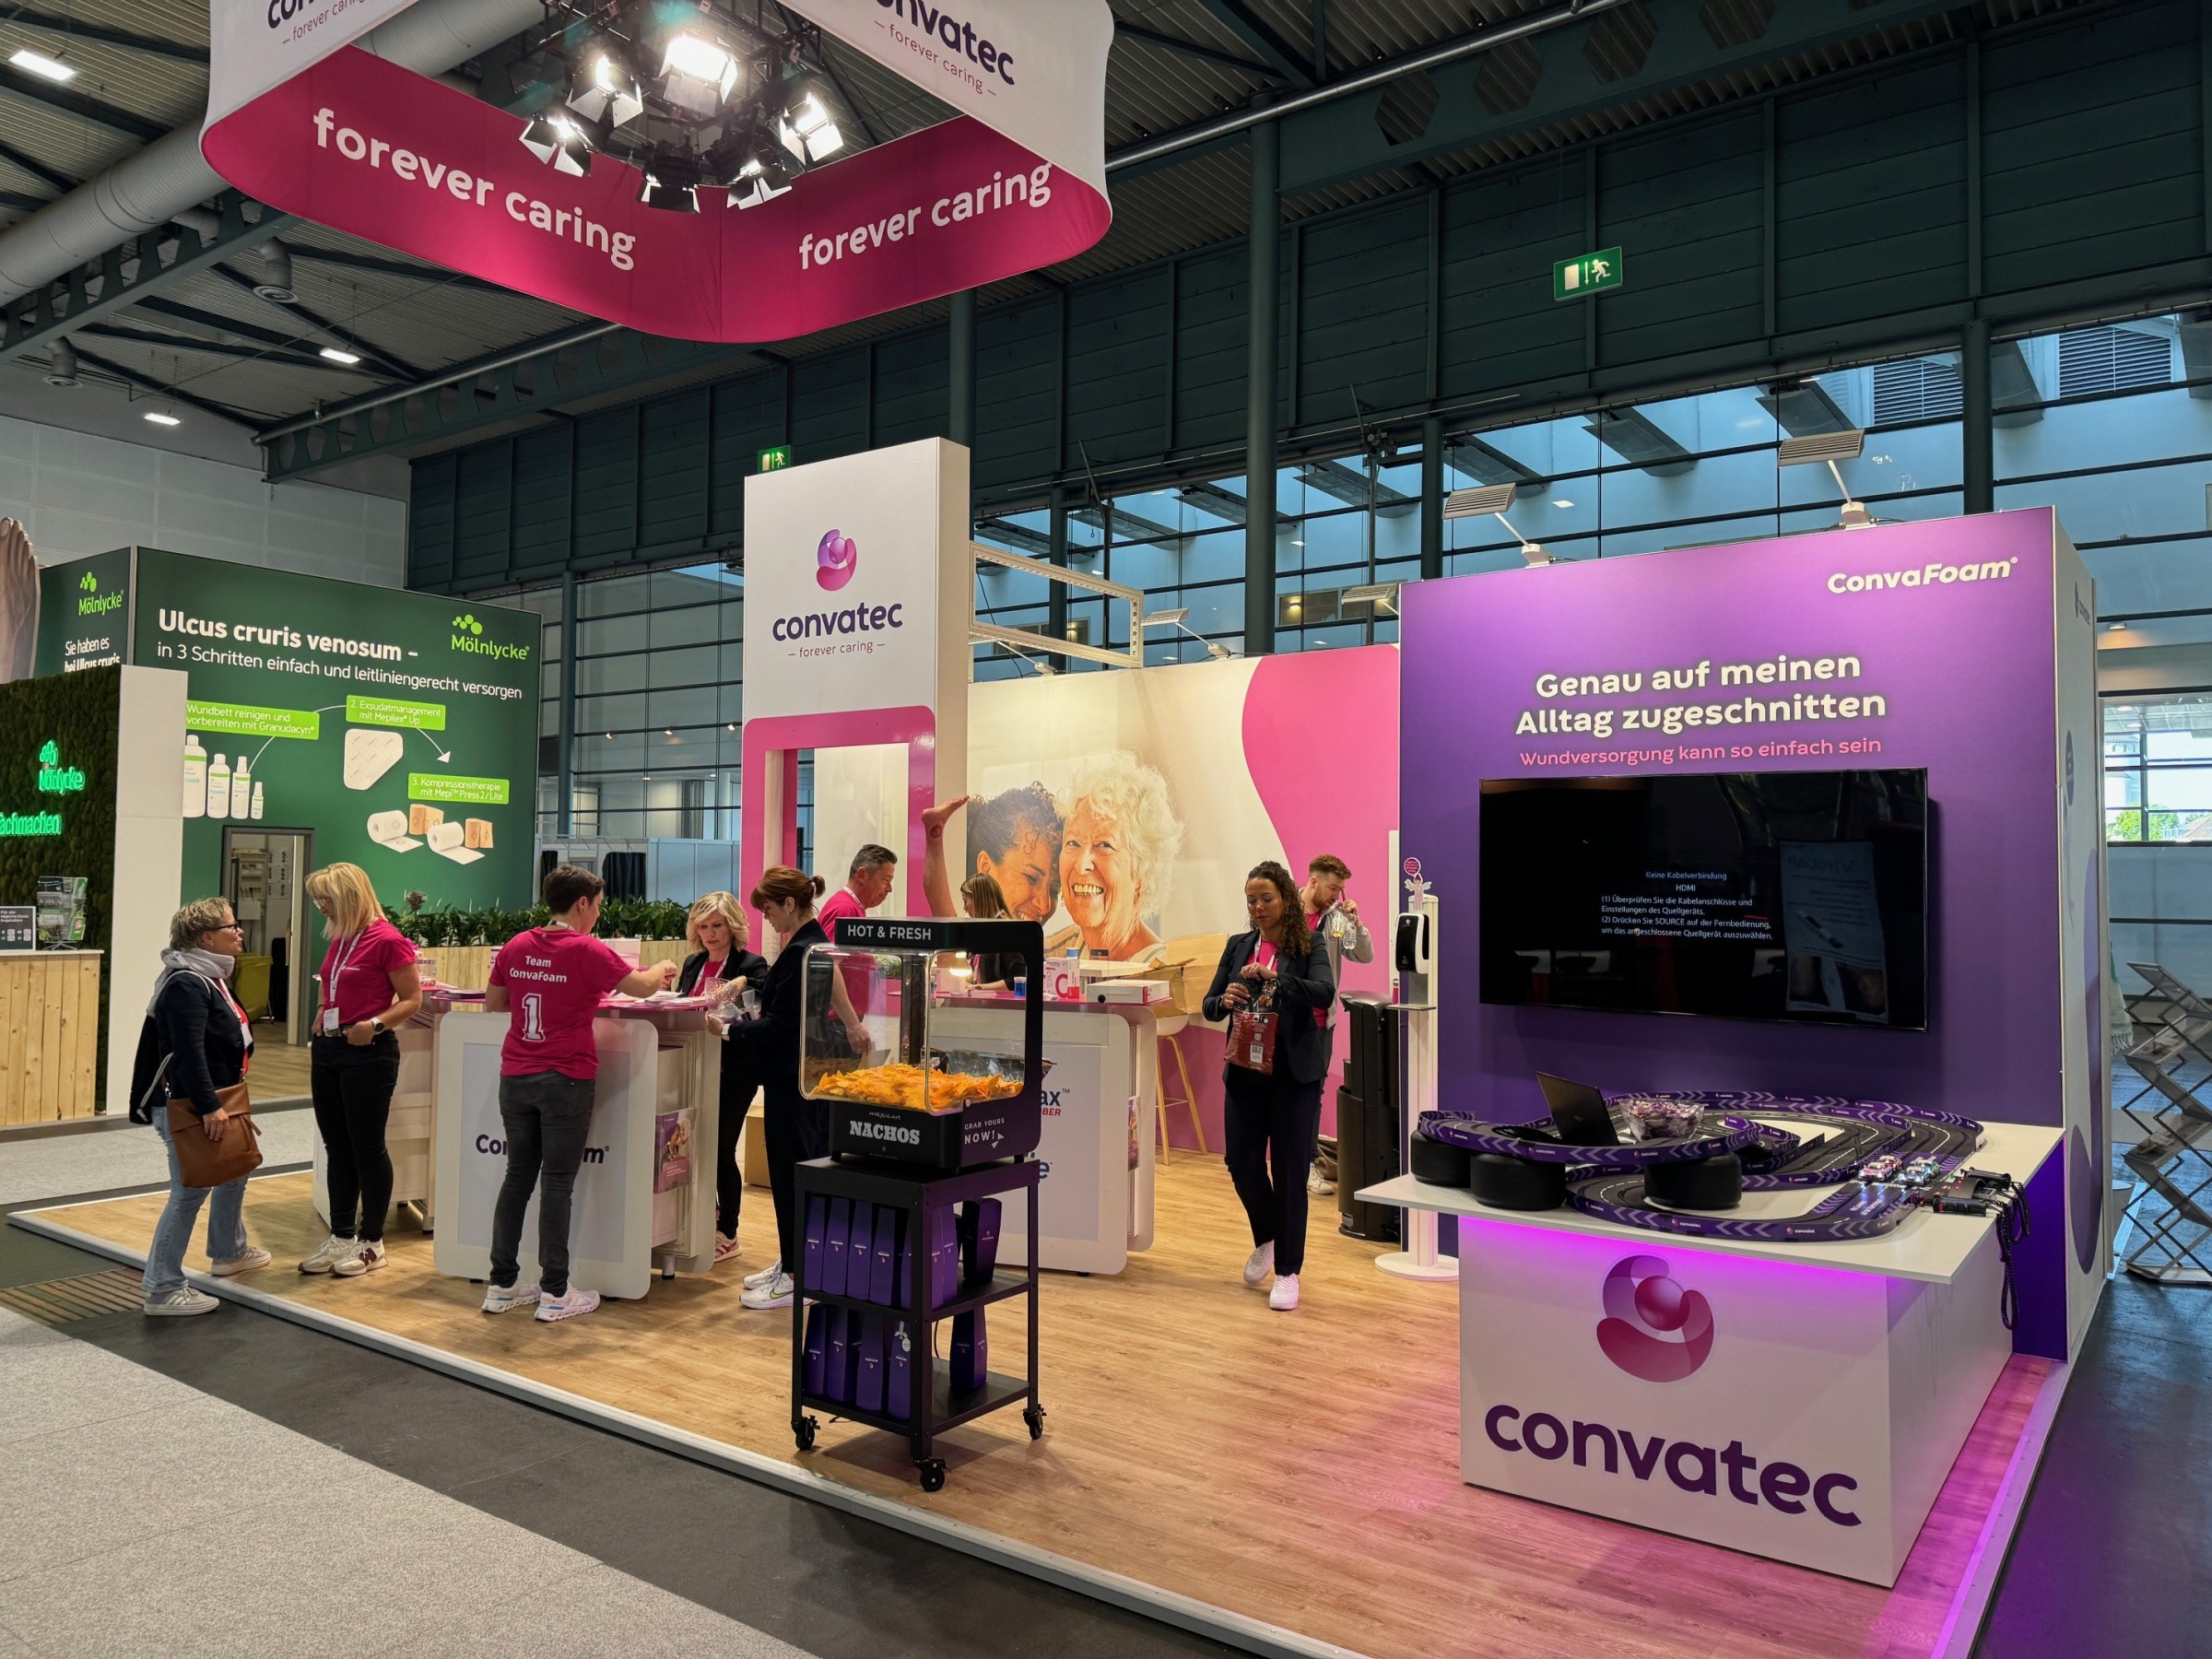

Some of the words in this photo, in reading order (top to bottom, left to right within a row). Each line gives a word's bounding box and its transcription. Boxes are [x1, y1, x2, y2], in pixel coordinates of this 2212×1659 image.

[292, 9, 330, 41] forever
[877, 0, 1016, 86] nvatec
[889, 24, 939, 64] forever
[943, 59, 984, 95] caring
[312, 108, 495, 206] forever
[505, 191, 637, 271] caring
[798, 206, 922, 270] forever
[931, 162, 1053, 228] caring
[772, 602, 903, 641] convatec
[159, 608, 228, 639] Ulcus
[233, 626, 302, 649] cruris
[307, 634, 402, 662] venosum
[65, 639, 76, 657] Sie
[76, 637, 100, 653] haben
[100, 637, 110, 651] es
[799, 645, 837, 658] forever
[840, 641, 874, 654] caring
[158, 641, 172, 658] in
[177, 643, 187, 660] 3
[192, 646, 263, 668] Schritten
[266, 656, 320, 676] einfach
[324, 665, 351, 679] und
[354, 665, 459, 691] leitliniengerecht
[462, 682, 523, 700] versorgen
[1535, 672, 1642, 699] Genau
[1651, 660, 1711, 691] auf
[1720, 654, 1862, 687] meinen
[186, 703, 232, 717] Wundbett
[235, 709, 272, 722] reinigen
[274, 713, 290, 723] und
[359, 700, 441, 718] Exsudatmanagement
[1514, 709, 1614, 738] Alltag
[1621, 692, 1887, 735] zugeschnitten
[186, 716, 241, 729] vorbereiten
[241, 722, 257, 731] mit
[359, 711, 372, 721] mit
[408, 716, 420, 726] Up
[1520, 745, 1675, 767] Wundversorgung
[1678, 744, 1726, 760] kann
[1730, 744, 1754, 759] so
[1758, 738, 1834, 758] einfach
[1838, 736, 1883, 754] sein
[419, 788, 433, 797] mit
[459, 791, 479, 800] Press
[420, 777, 501, 793] Kompressionstherapie
[1667, 871, 1727, 880] Kabelverbindung
[1676, 884, 1696, 892] HDMI
[1601, 895, 1611, 903] (1)
[1612, 894, 1652, 905] Überprüfen
[1677, 897, 1736, 906] Kabelanschlüsse
[1601, 905, 1648, 914] Einstellungen
[1662, 907, 1706, 916] Quellgeräts.
[1601, 916, 1611, 924] (2)
[1612, 916, 1641, 924] Drücken
[1642, 917, 1653, 925] Sie
[1687, 918, 1698, 926] auf
[1713, 919, 1771, 930] Fernbedienung,
[847, 924, 874, 939] HOT
[877, 925, 887, 939] &
[888, 925, 932, 941] FRESH
[1683, 929, 1722, 938] Quellgerät
[1724, 931, 1773, 940] auszuwählen.
[525, 955, 552, 968] Team
[509, 967, 568, 983] ConvaFoam
[522, 993, 546, 1042] 1
[849, 1120, 921, 1146] NACHOS
[964, 1122, 982, 1131] GRAB
[983, 1117, 1005, 1127] YOURS
[964, 1130, 995, 1145] NOW!
[1485, 1404, 1863, 1527] convatec
